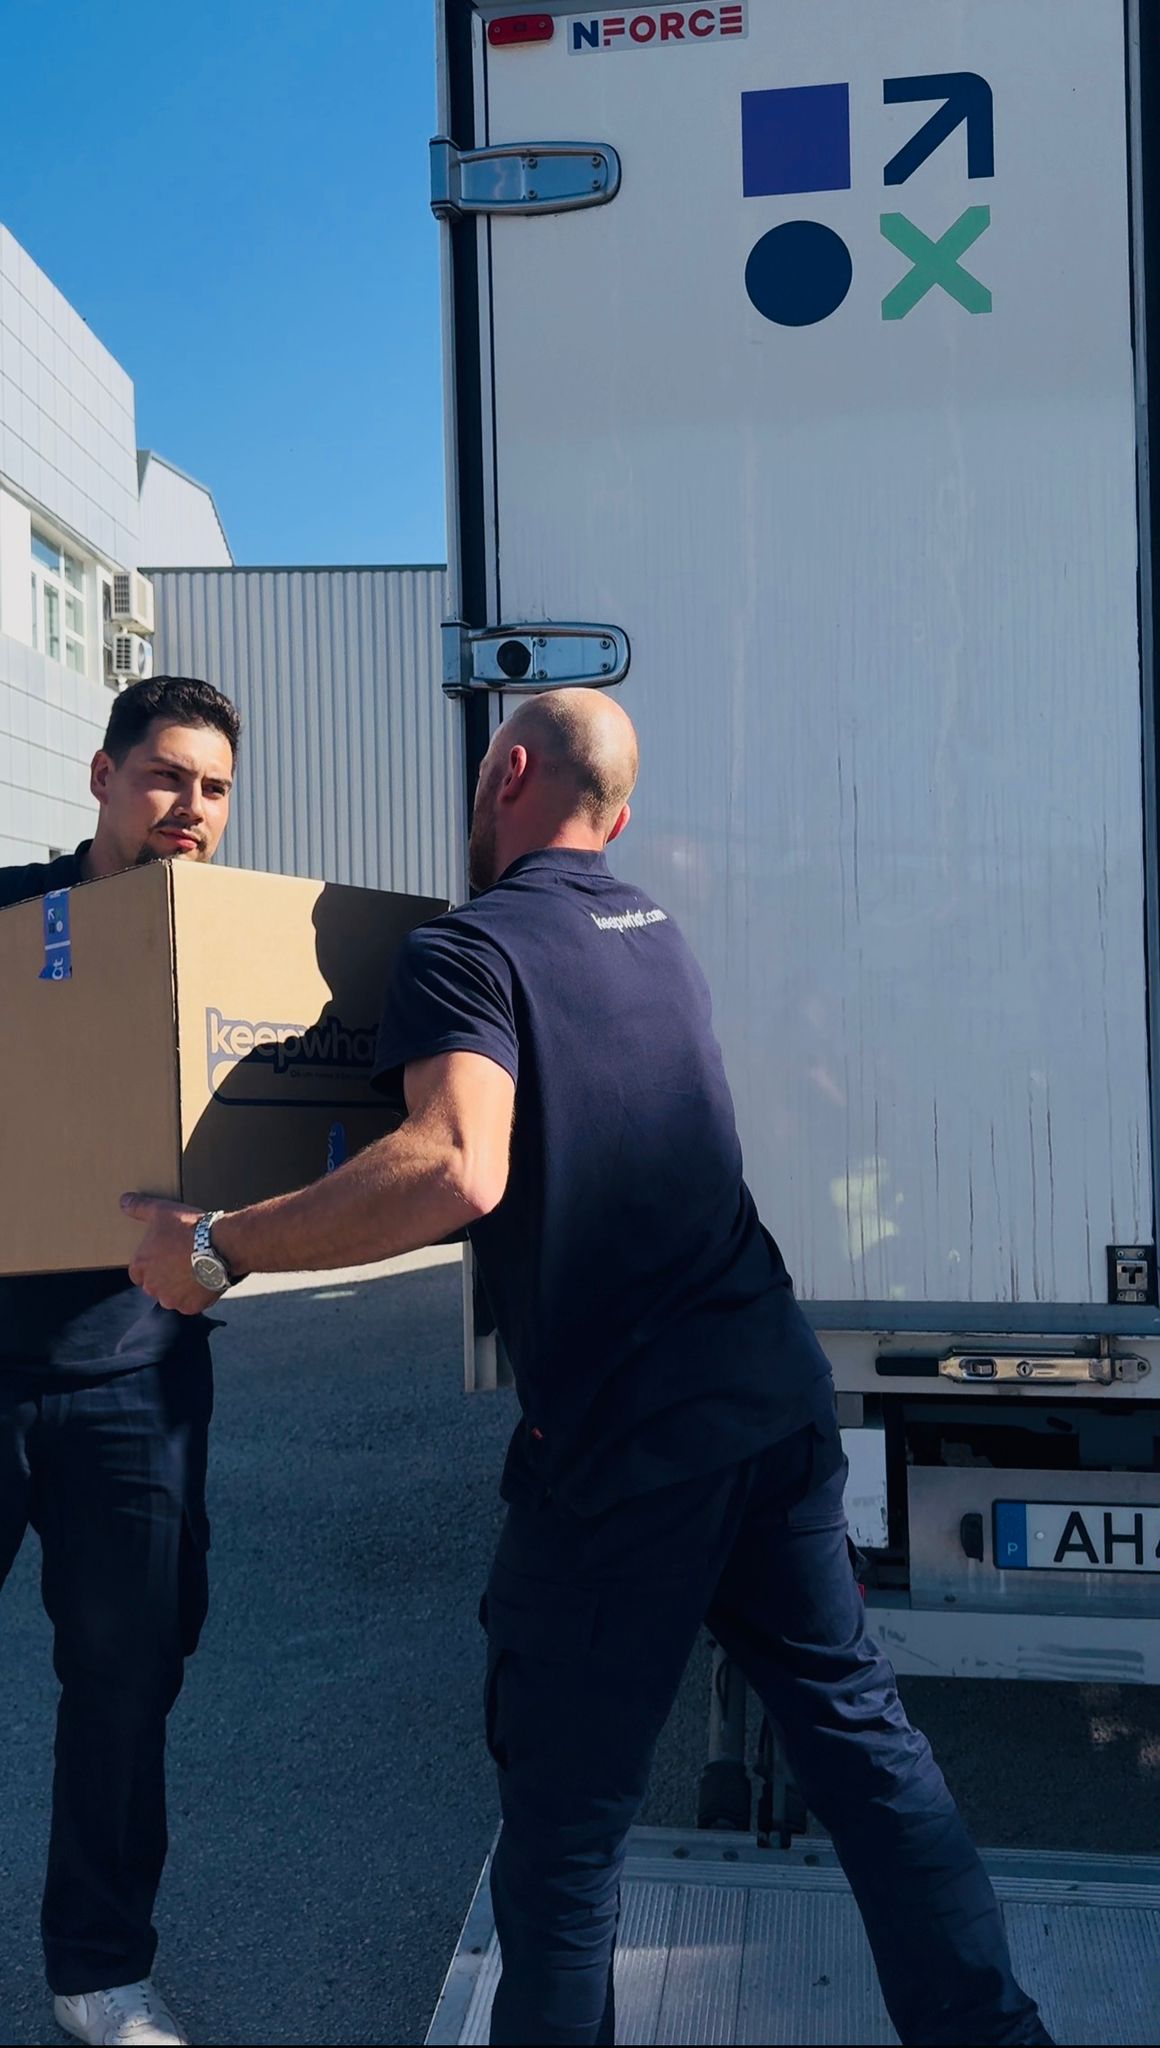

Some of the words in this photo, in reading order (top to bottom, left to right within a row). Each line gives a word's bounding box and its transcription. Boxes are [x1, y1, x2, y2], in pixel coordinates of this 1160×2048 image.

[573, 5, 743, 49] NFORCE
[590, 908, 668, 933] keepwhat.com
[1007, 1542, 1018, 1556] P
[1053, 1510, 1160, 1565] AH
